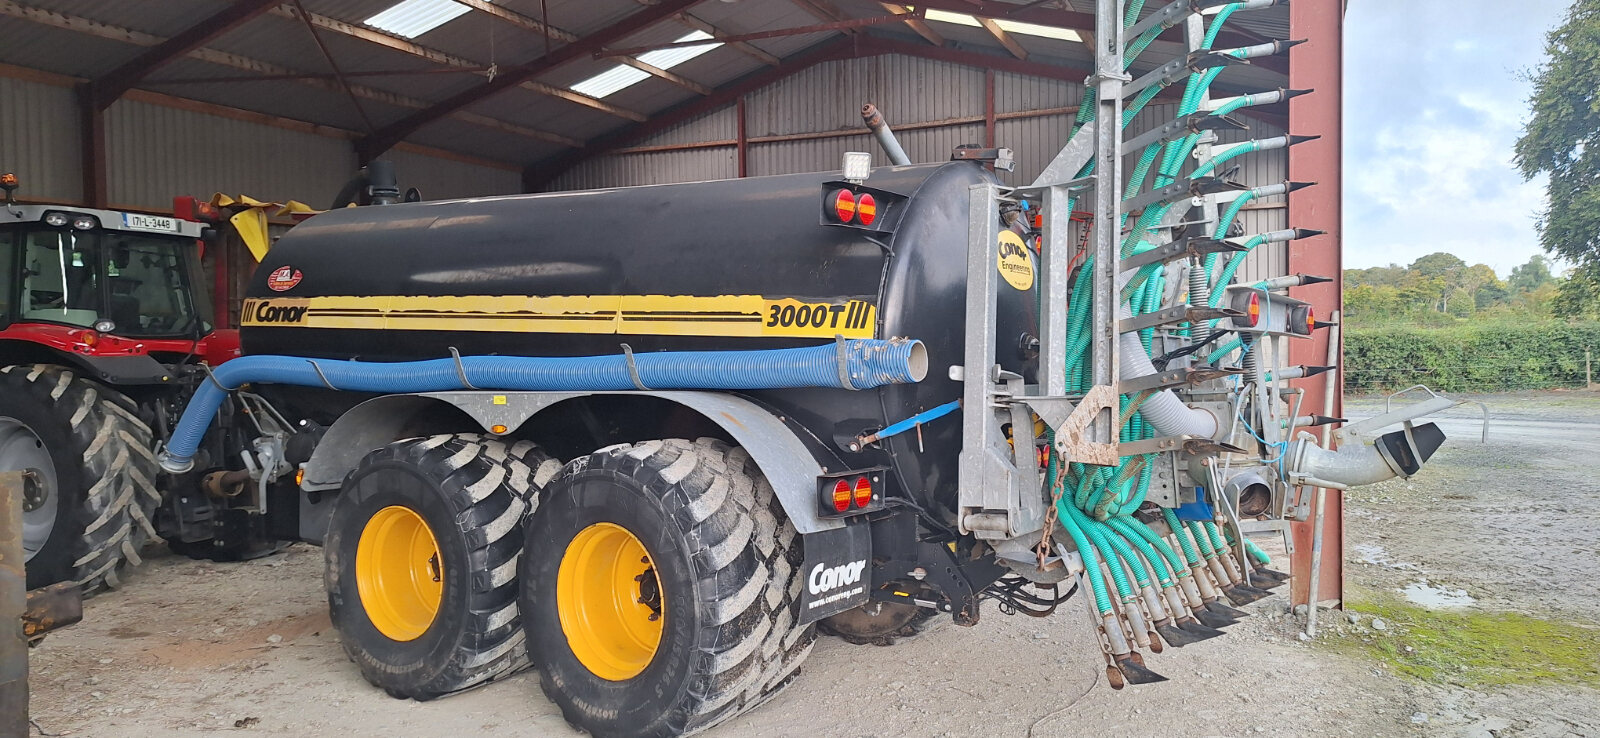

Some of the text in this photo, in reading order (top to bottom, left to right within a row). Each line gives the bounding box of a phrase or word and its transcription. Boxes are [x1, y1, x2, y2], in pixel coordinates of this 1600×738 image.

[998, 241, 1027, 261] Conor
[256, 301, 308, 322] Conor
[766, 304, 846, 328] 3000T
[808, 559, 866, 595] Conor
[808, 587, 863, 610] www.conoreng.com
